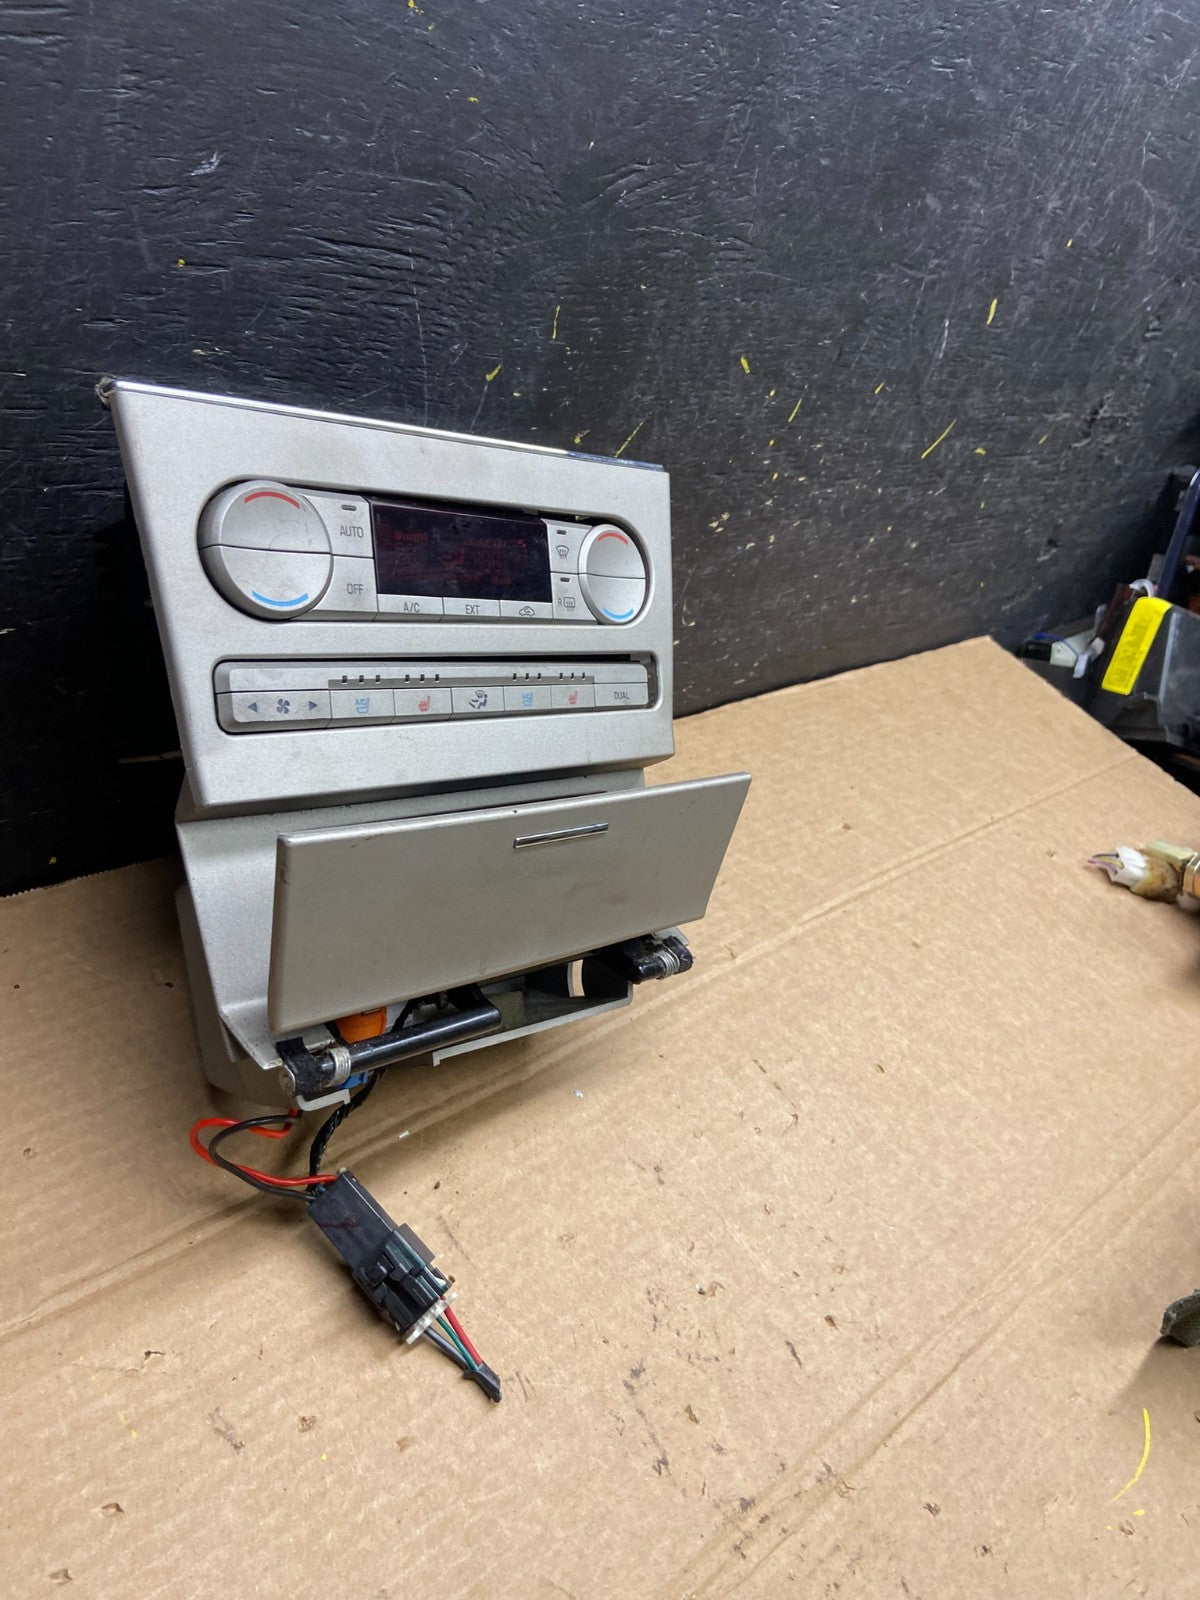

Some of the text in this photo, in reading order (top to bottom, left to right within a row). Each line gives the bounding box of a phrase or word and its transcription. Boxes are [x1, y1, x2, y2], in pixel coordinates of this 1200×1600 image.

[339, 524, 364, 539] AUTO
[346, 582, 364, 595] OFF
[403, 602, 420, 613] A/C
[465, 604, 480, 615] EXT
[614, 690, 630, 701] DUAL
